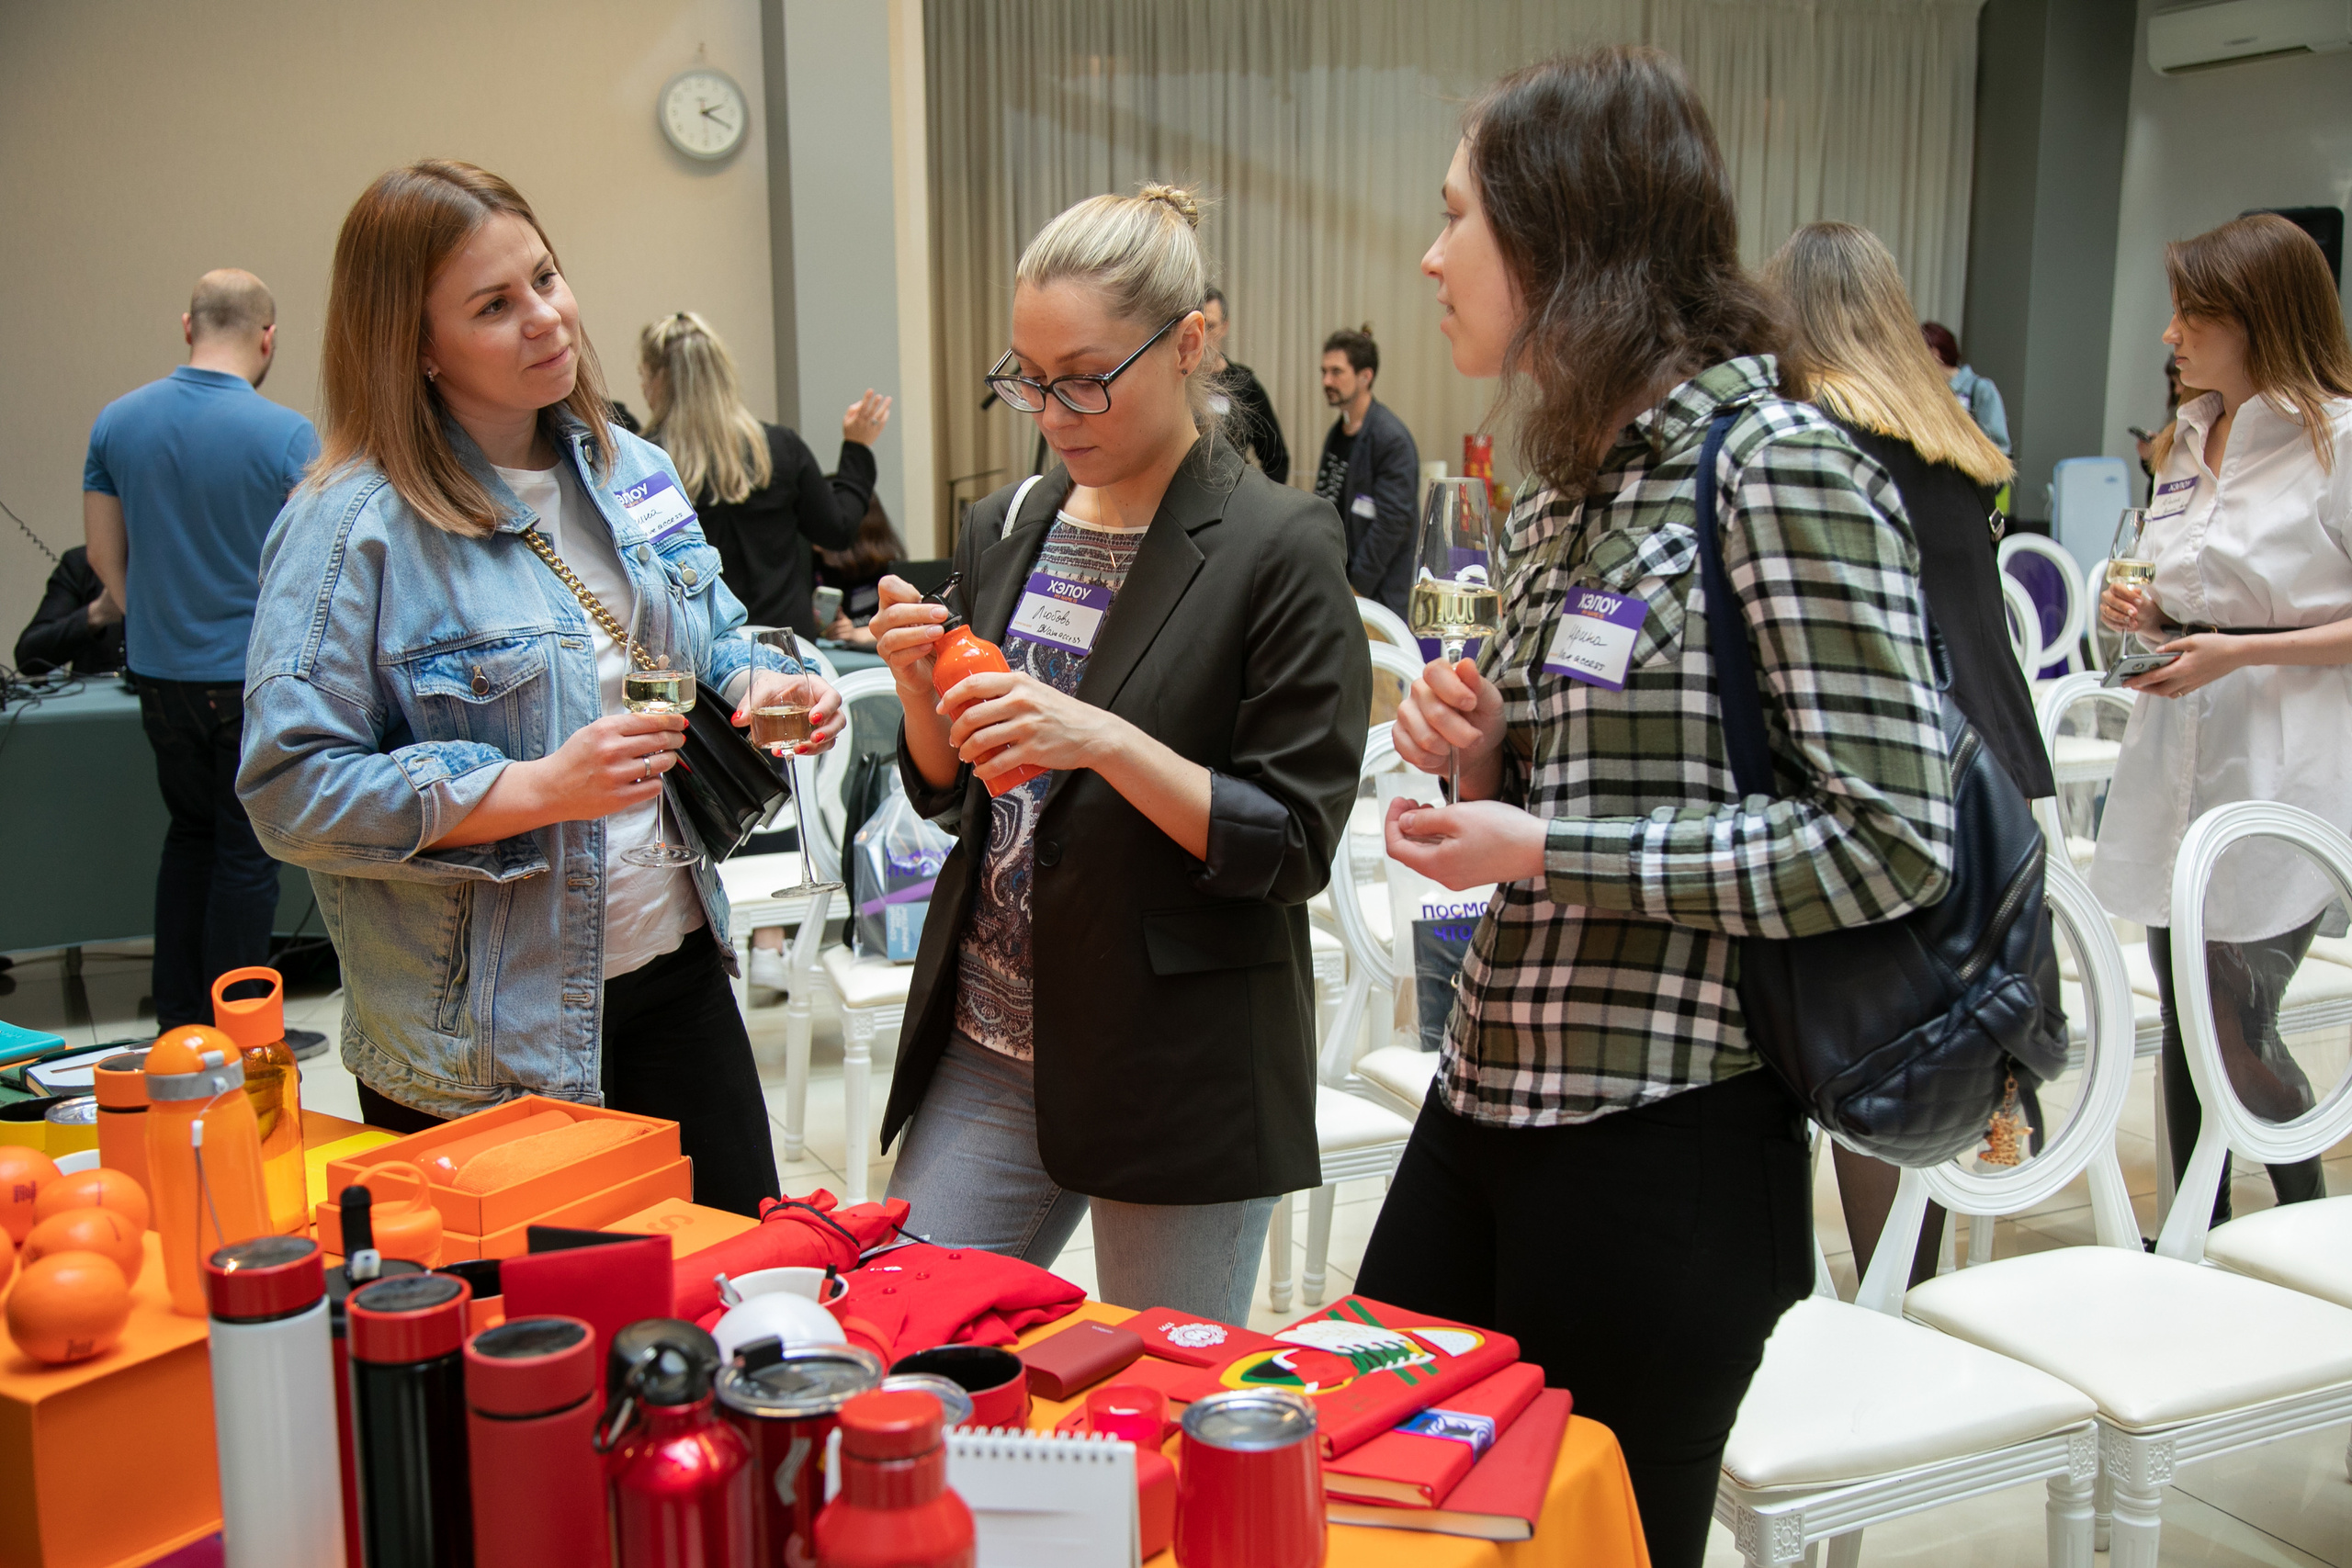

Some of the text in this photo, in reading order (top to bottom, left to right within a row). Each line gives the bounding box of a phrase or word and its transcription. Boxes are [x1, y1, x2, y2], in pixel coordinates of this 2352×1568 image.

[615, 482, 648, 505] ЭЛОУ
[1046, 580, 1091, 600] ХЭЛОУ
[1577, 592, 1623, 615] ХЭЛОУ
[1032, 605, 1070, 626] Любовь
[1434, 925, 1473, 942] ЧТО
